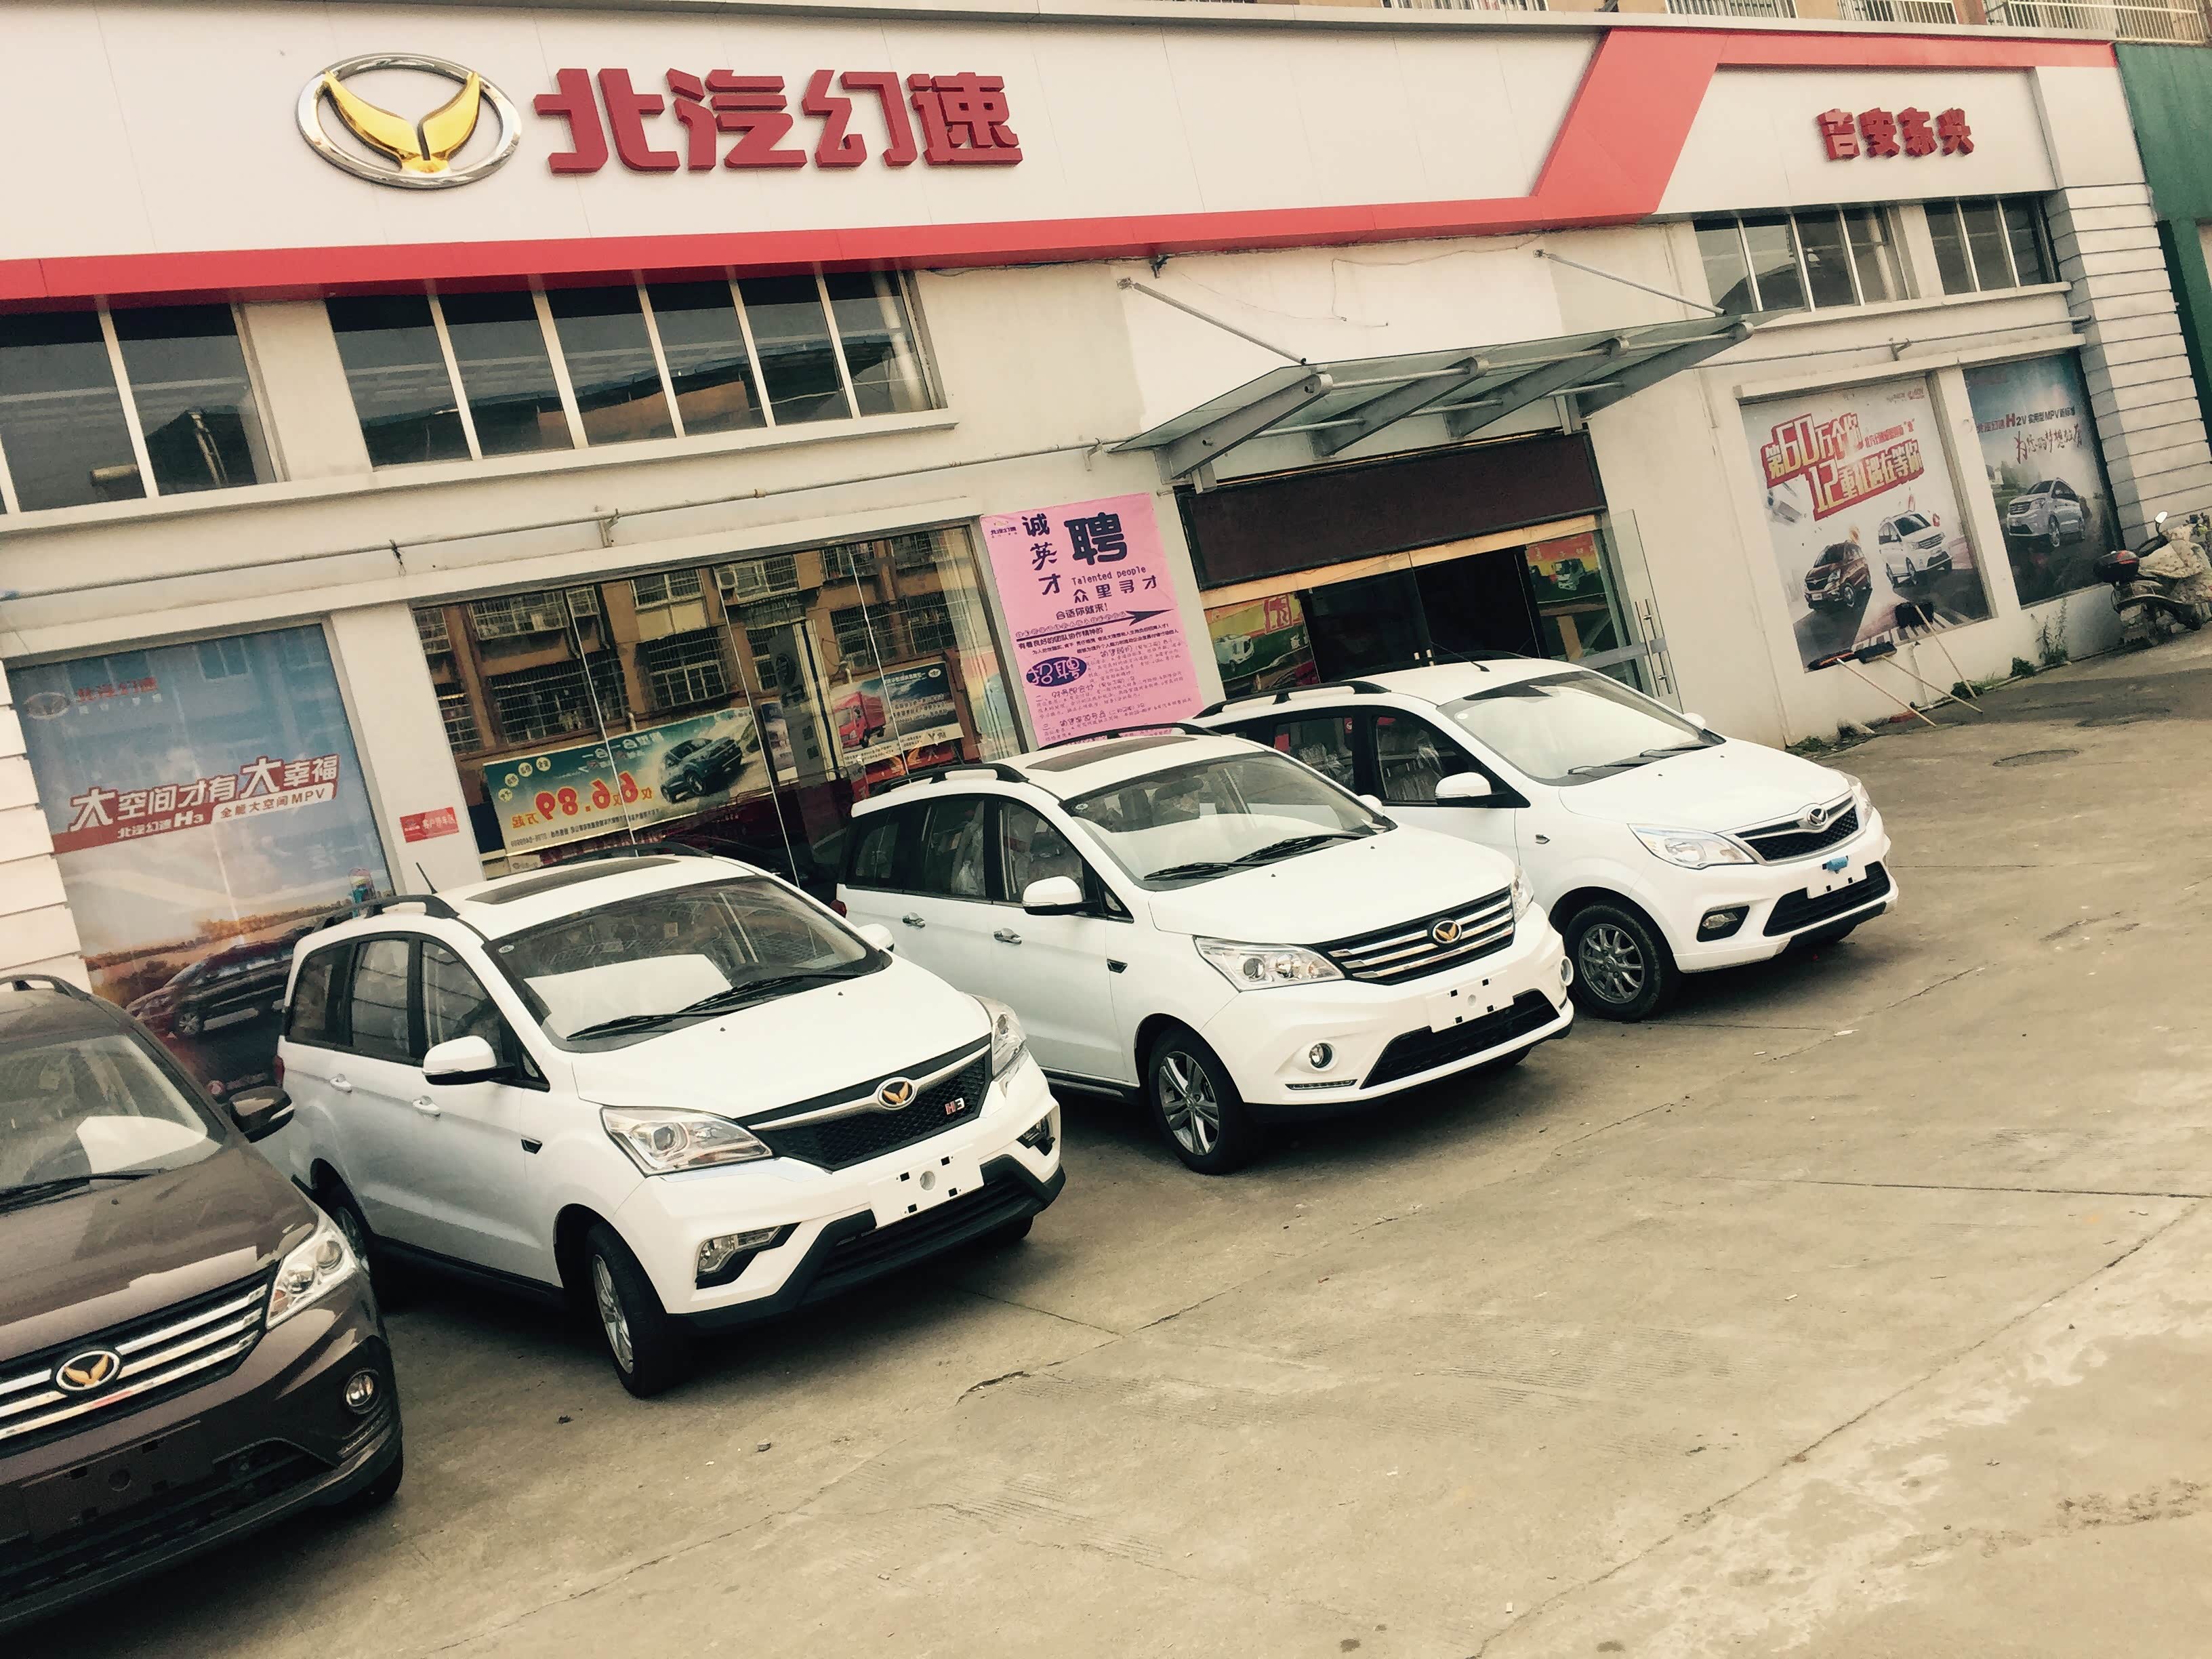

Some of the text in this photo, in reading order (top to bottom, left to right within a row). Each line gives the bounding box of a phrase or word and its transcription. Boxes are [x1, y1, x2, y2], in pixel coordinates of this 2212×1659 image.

[533, 67, 1023, 179] 北汽幻速
[1071, 565, 1147, 587] Talented people
[1073, 575, 1158, 604] 众里寻才
[70, 755, 338, 832] 大空间才有大幸福
[220, 787, 326, 819] 全能大空间MPV
